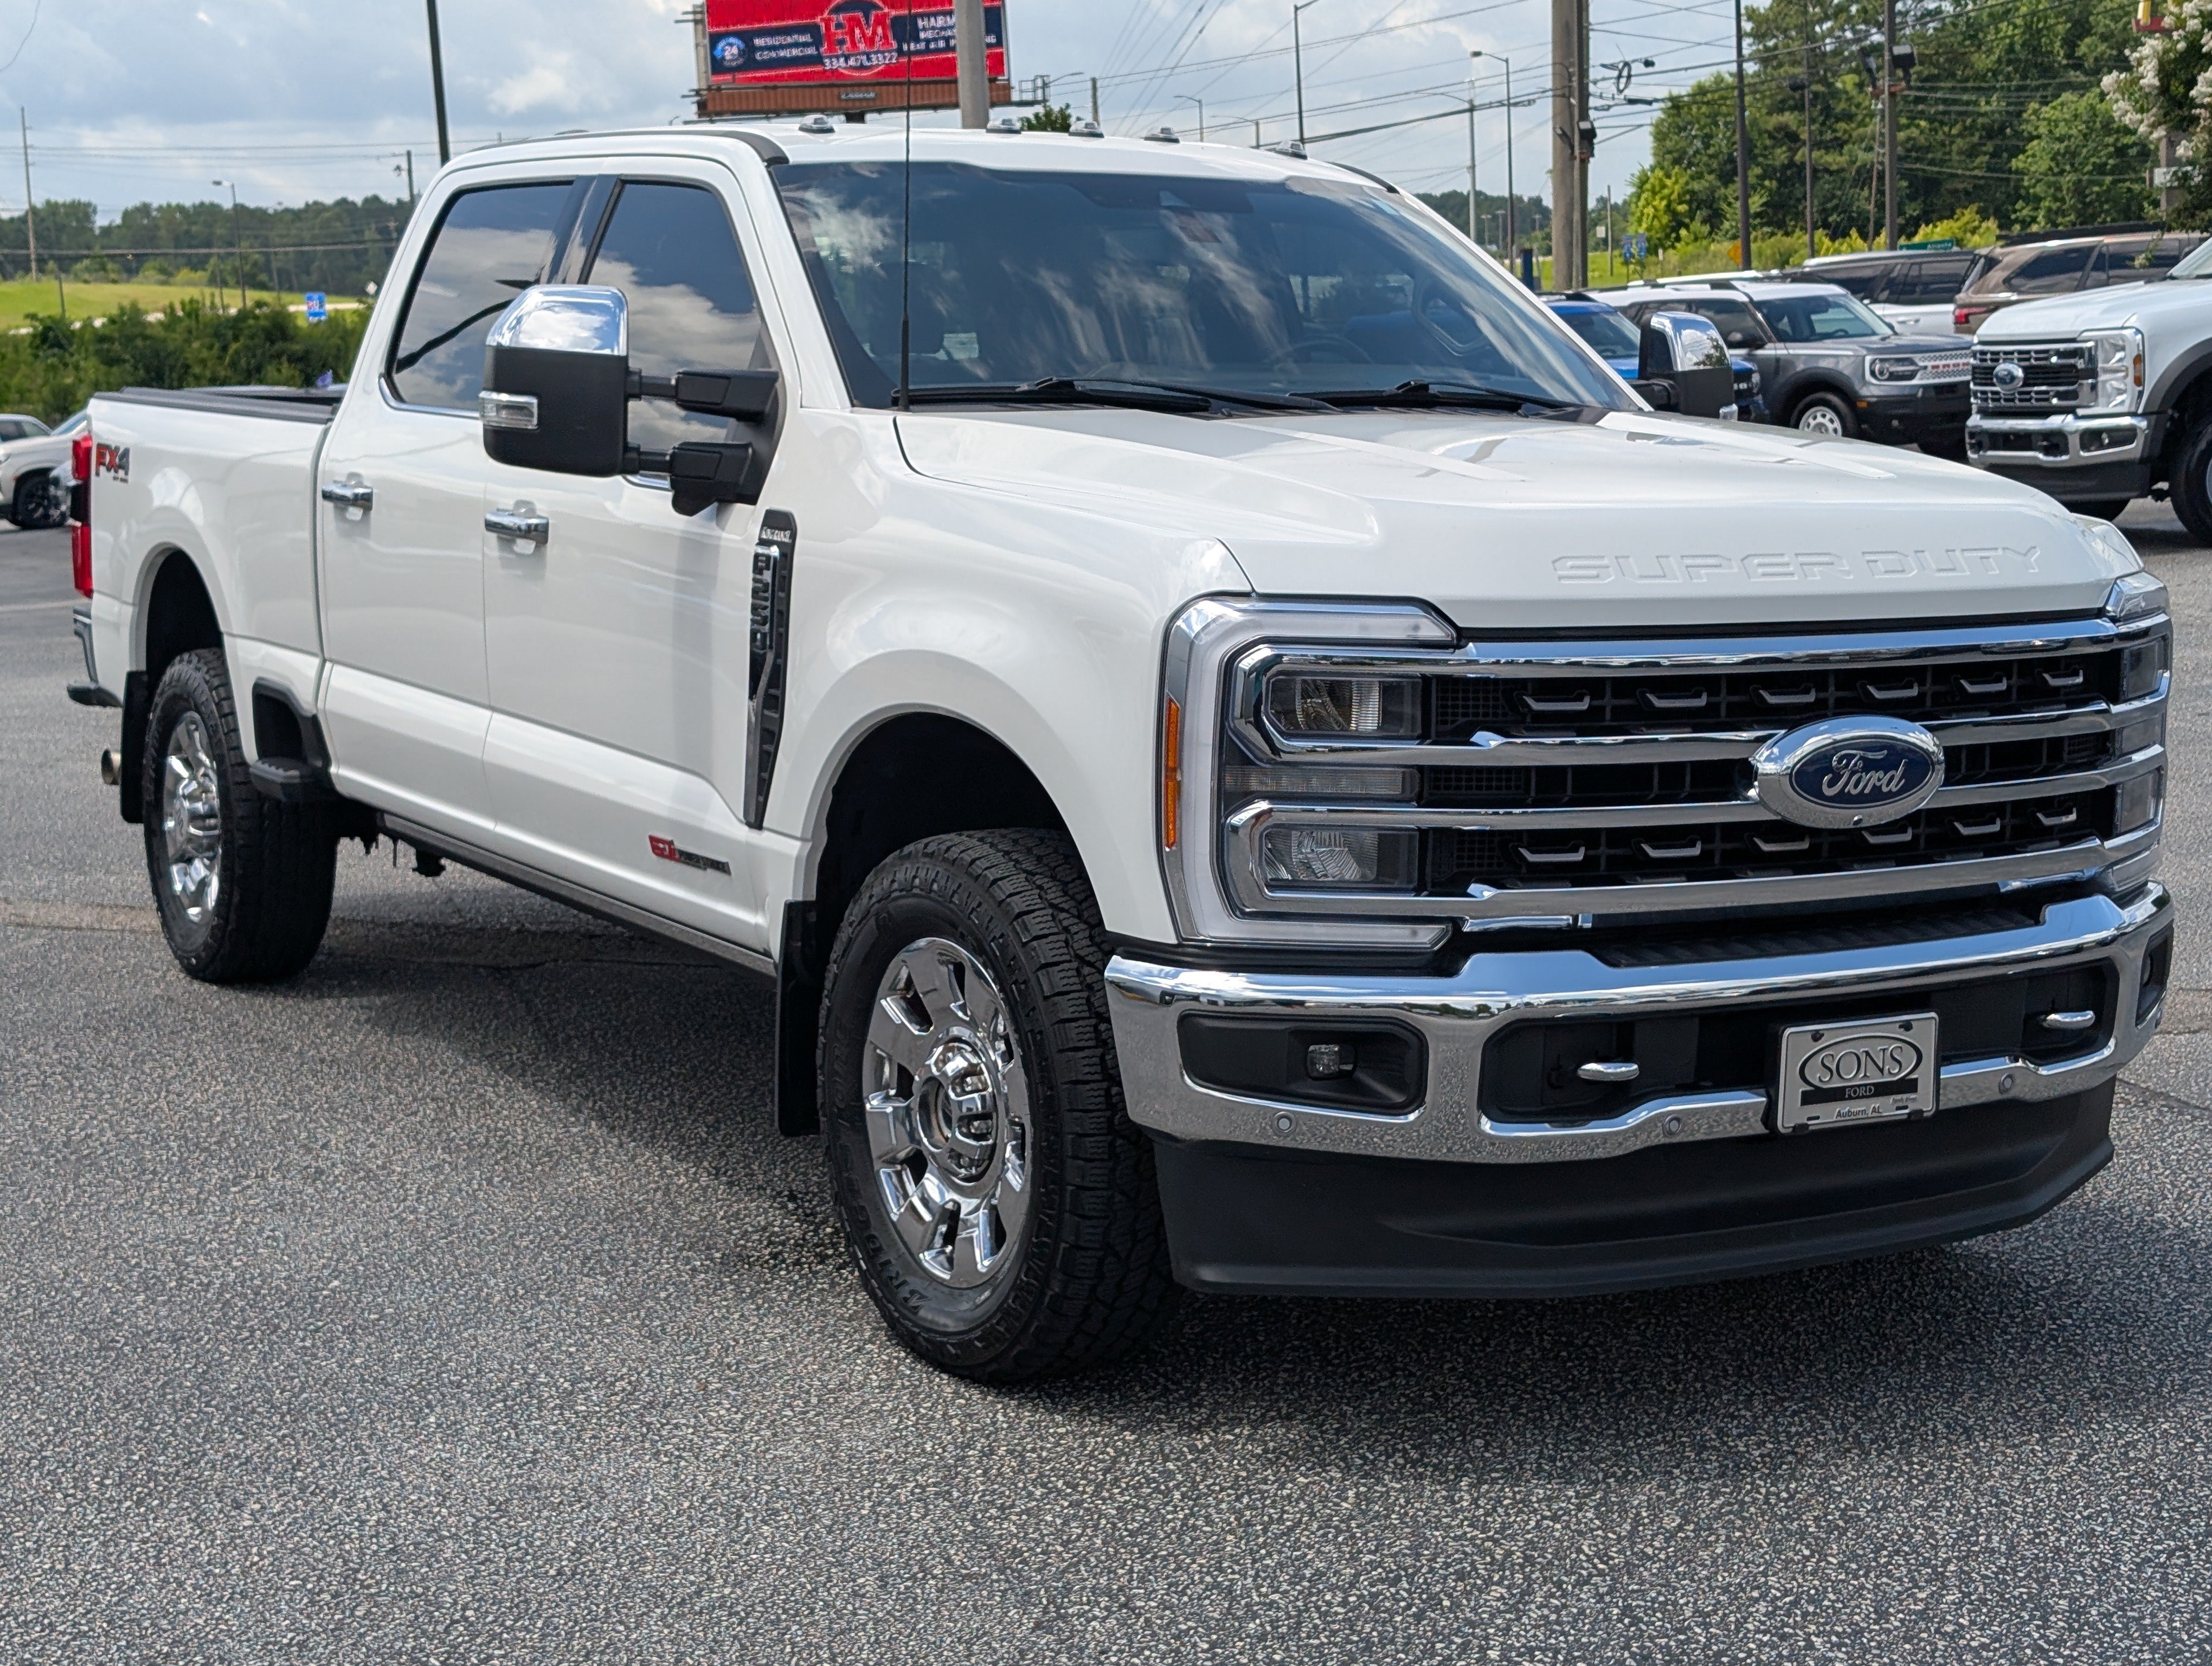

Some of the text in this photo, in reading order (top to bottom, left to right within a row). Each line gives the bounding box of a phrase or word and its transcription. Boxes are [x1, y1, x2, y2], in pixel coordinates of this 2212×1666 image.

[819, 10, 898, 56] HM
[95, 443, 130, 477] FX4
[1551, 546, 2041, 584] SUPER DUTY
[1823, 750, 1908, 796] Ford
[1817, 1044, 1903, 1082] SONS
[1835, 1103, 1882, 1119] Auburn, AL
[1845, 1085, 1875, 1099] FORD
